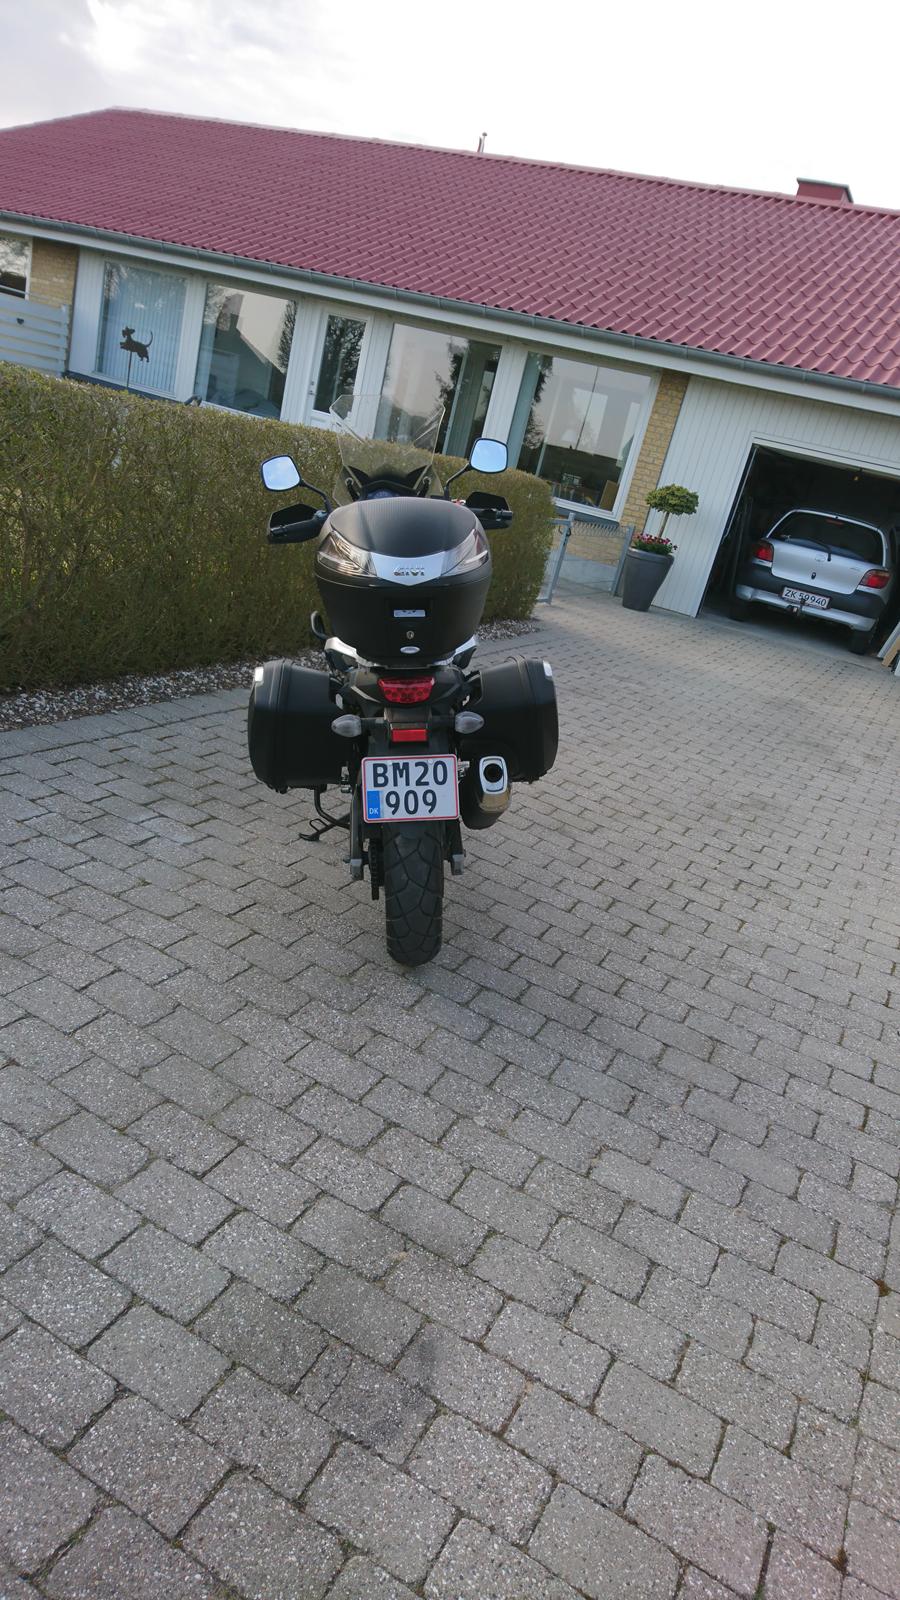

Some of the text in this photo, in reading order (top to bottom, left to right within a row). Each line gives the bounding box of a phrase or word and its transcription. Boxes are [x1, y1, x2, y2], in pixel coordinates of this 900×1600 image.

[784, 589, 827, 607] ZK 59940
[372, 760, 448, 788] BM20
[369, 807, 379, 815] DK
[385, 789, 438, 816] 909
